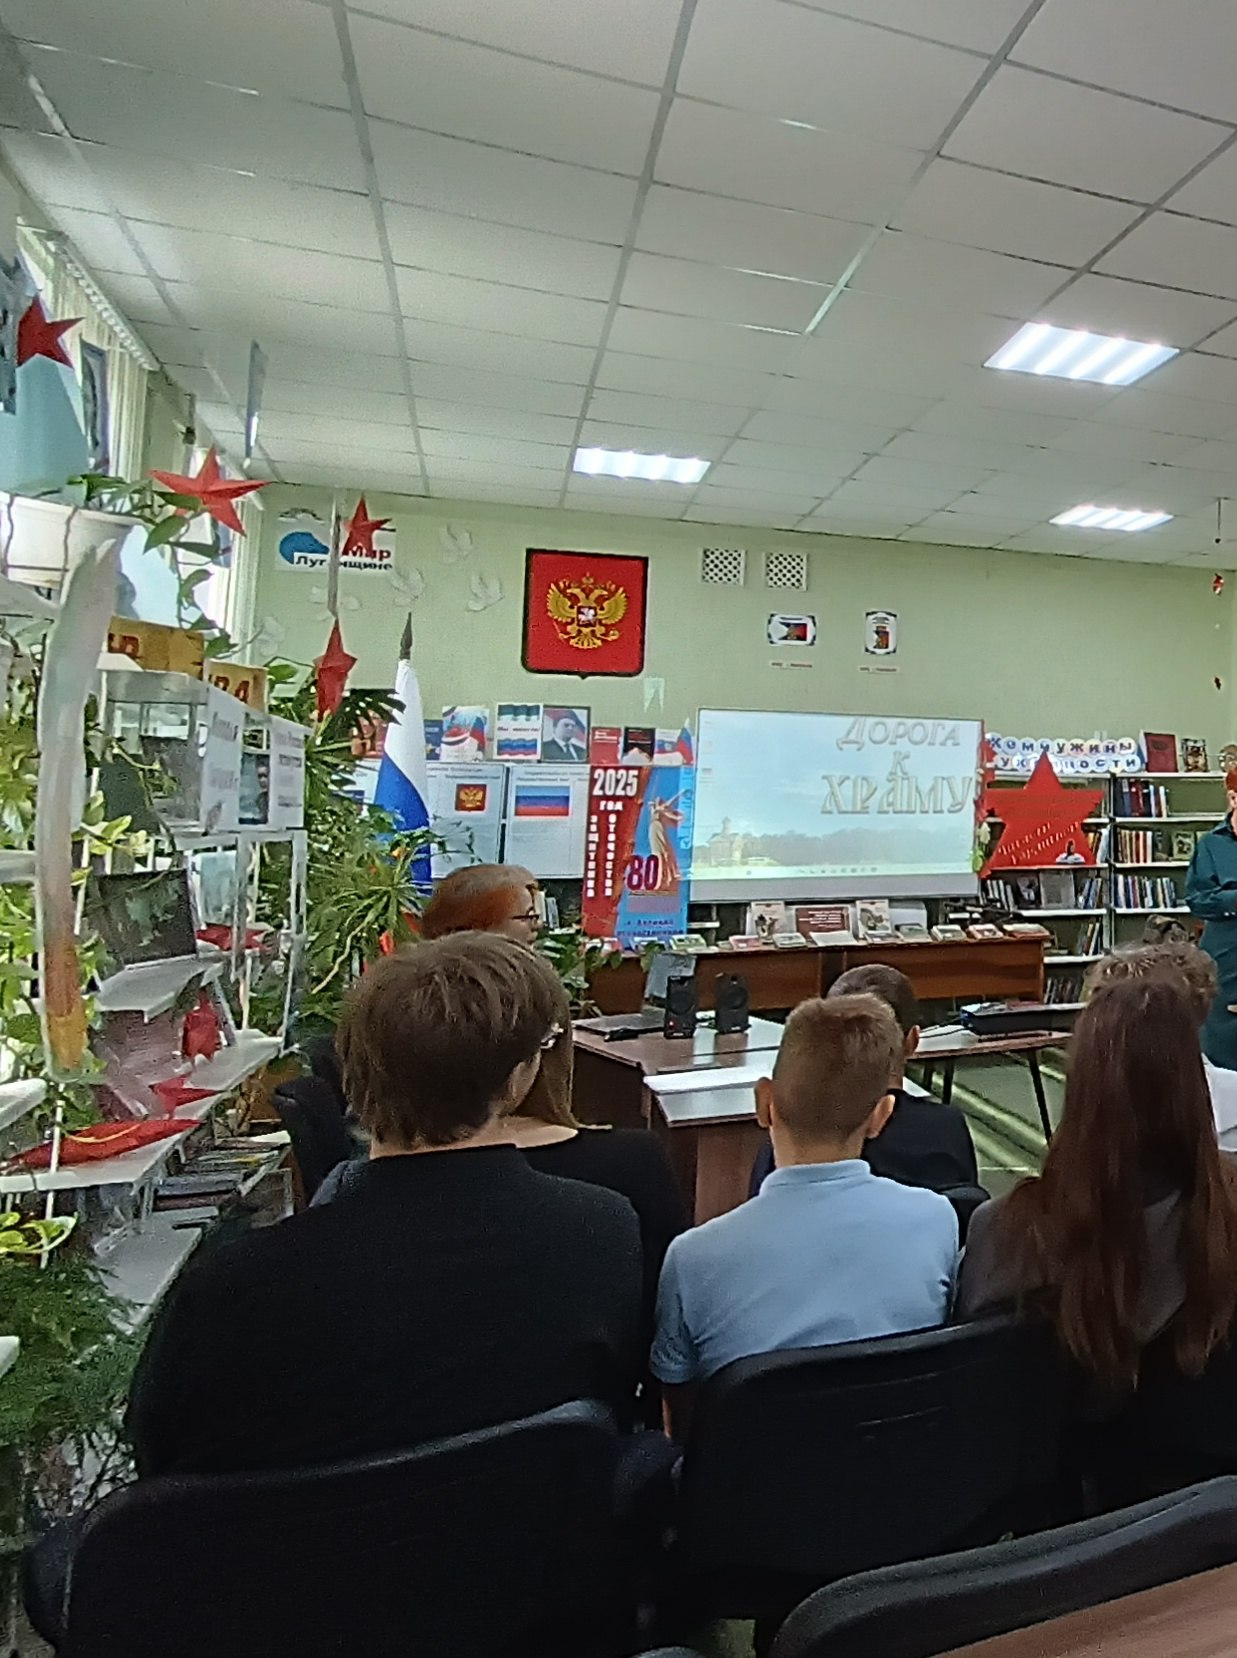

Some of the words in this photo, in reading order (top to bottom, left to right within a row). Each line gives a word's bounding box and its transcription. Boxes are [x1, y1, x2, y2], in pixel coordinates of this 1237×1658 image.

[836, 718, 960, 751] ДОРОГА
[592, 769, 638, 797] 2025
[821, 774, 972, 814] ХРАМУ
[626, 854, 660, 891] 80
